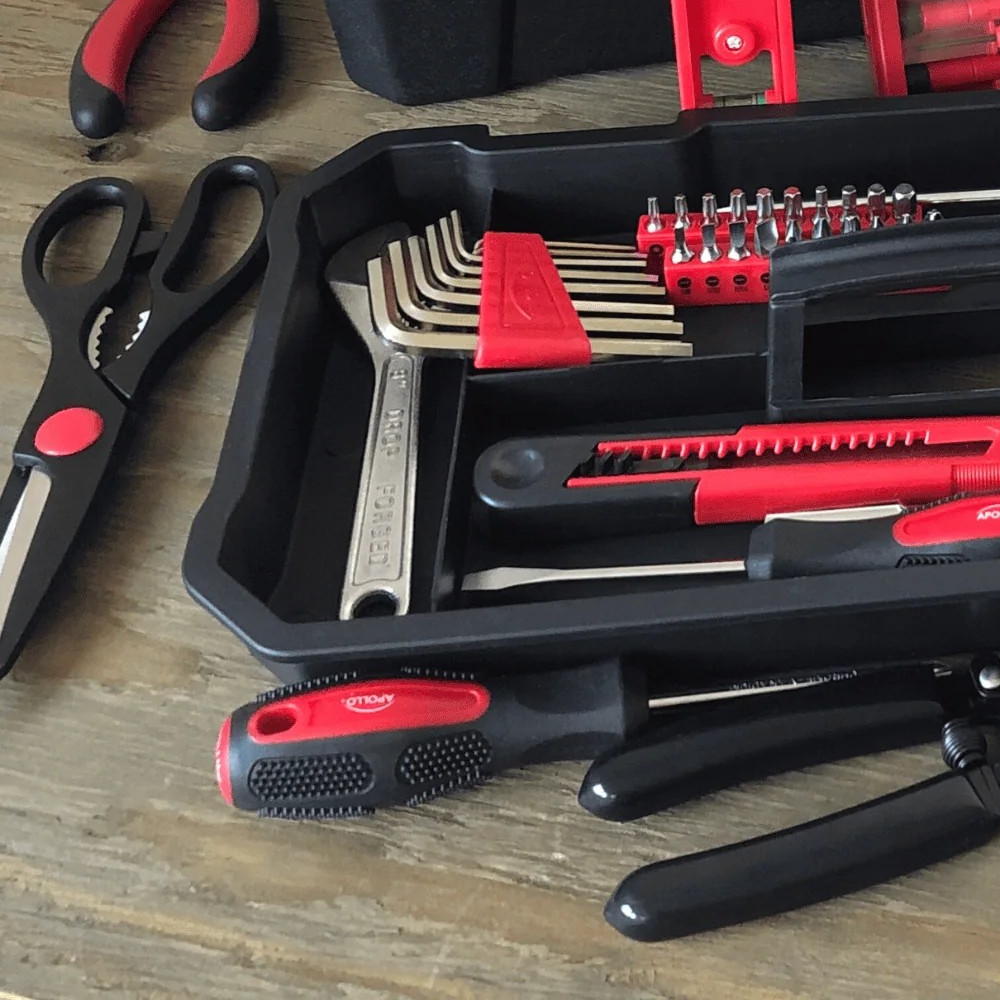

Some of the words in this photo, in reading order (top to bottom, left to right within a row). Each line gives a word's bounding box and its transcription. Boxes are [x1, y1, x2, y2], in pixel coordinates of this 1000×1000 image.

[380, 408, 405, 457] DROP
[368, 484, 396, 566] FORGED
[346, 693, 395, 707] APOLLO
